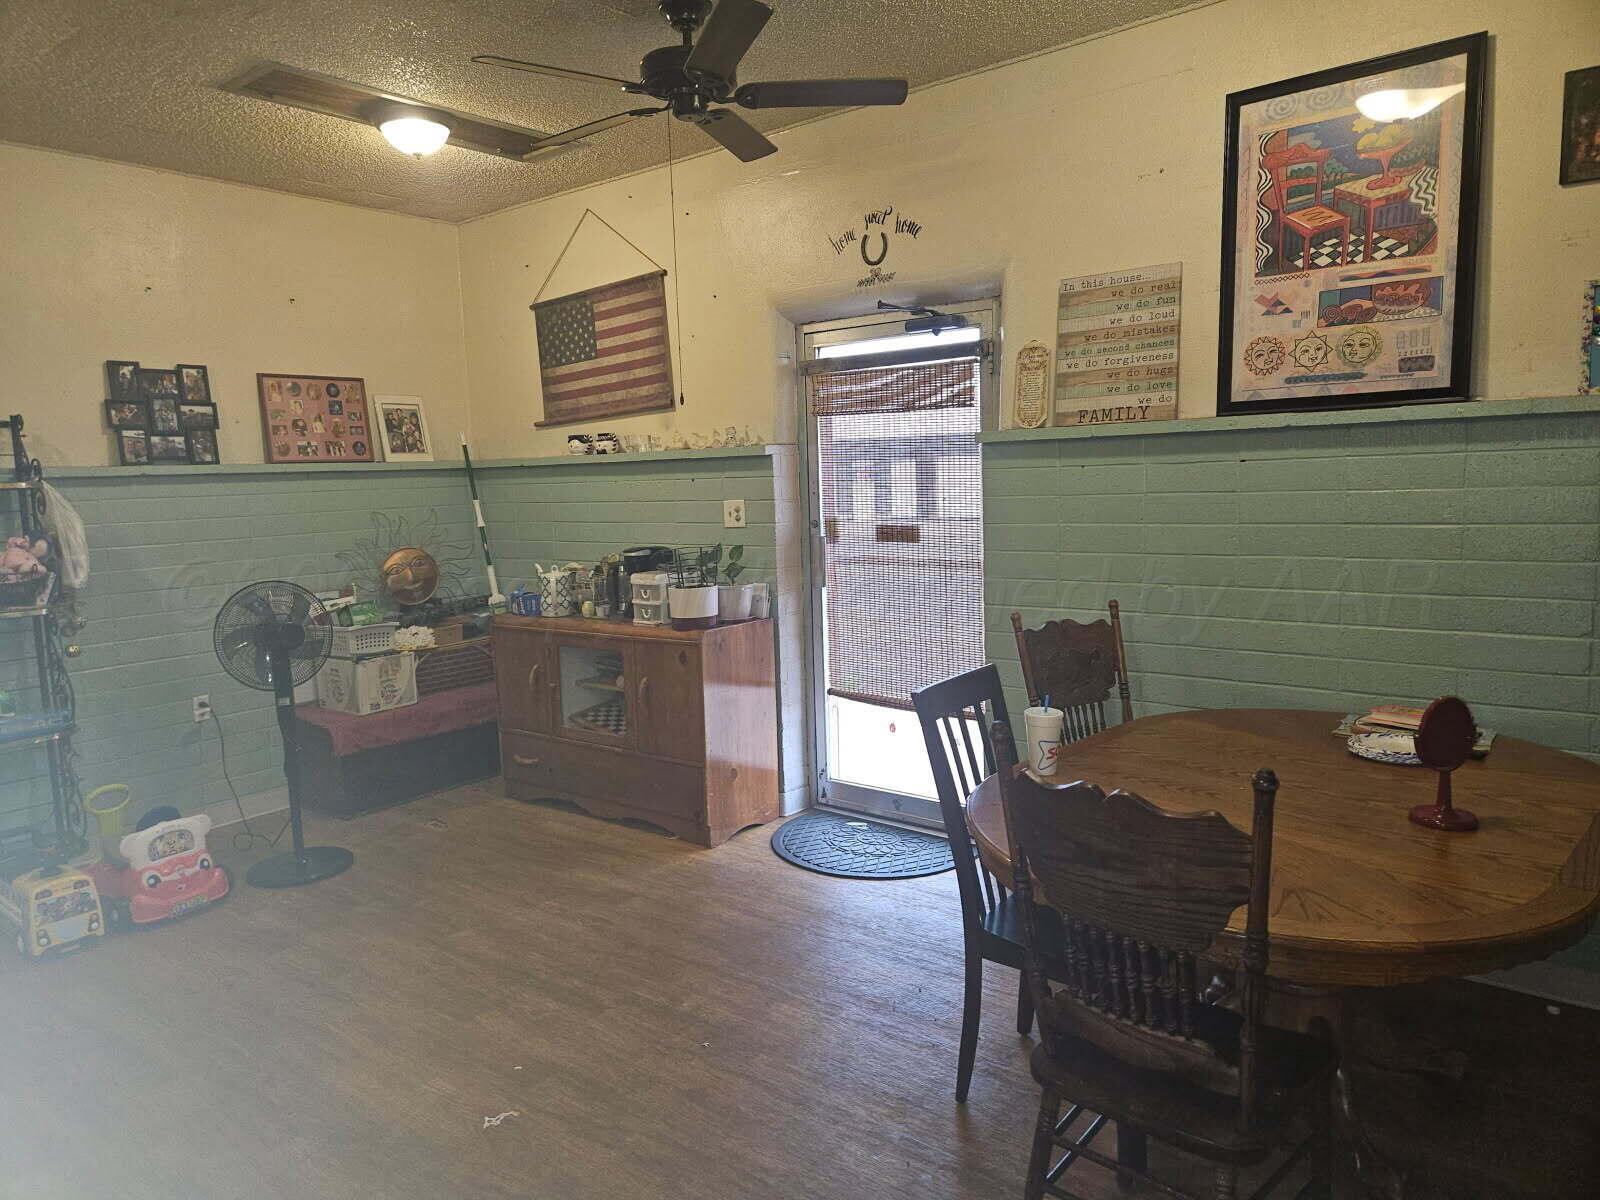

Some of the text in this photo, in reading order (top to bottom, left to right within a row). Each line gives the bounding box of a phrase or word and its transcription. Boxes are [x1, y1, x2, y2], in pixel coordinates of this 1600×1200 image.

[1064, 284, 1075, 292] In
[1082, 279, 1104, 288] this
[1111, 281, 1176, 297] we do real
[1115, 295, 1176, 311] we do fun
[1109, 310, 1175, 325] we do loud
[1084, 325, 1175, 342] we do mistakes
[1064, 339, 1175, 358] we do second chances
[1066, 352, 1174, 369] we do forgiveness
[1127, 368, 1139, 377] do
[1146, 366, 1174, 377] hugs
[1127, 382, 1139, 391] do
[1146, 379, 1173, 390] love
[1138, 393, 1172, 404] we do
[1077, 406, 1151, 423] FAMILY
